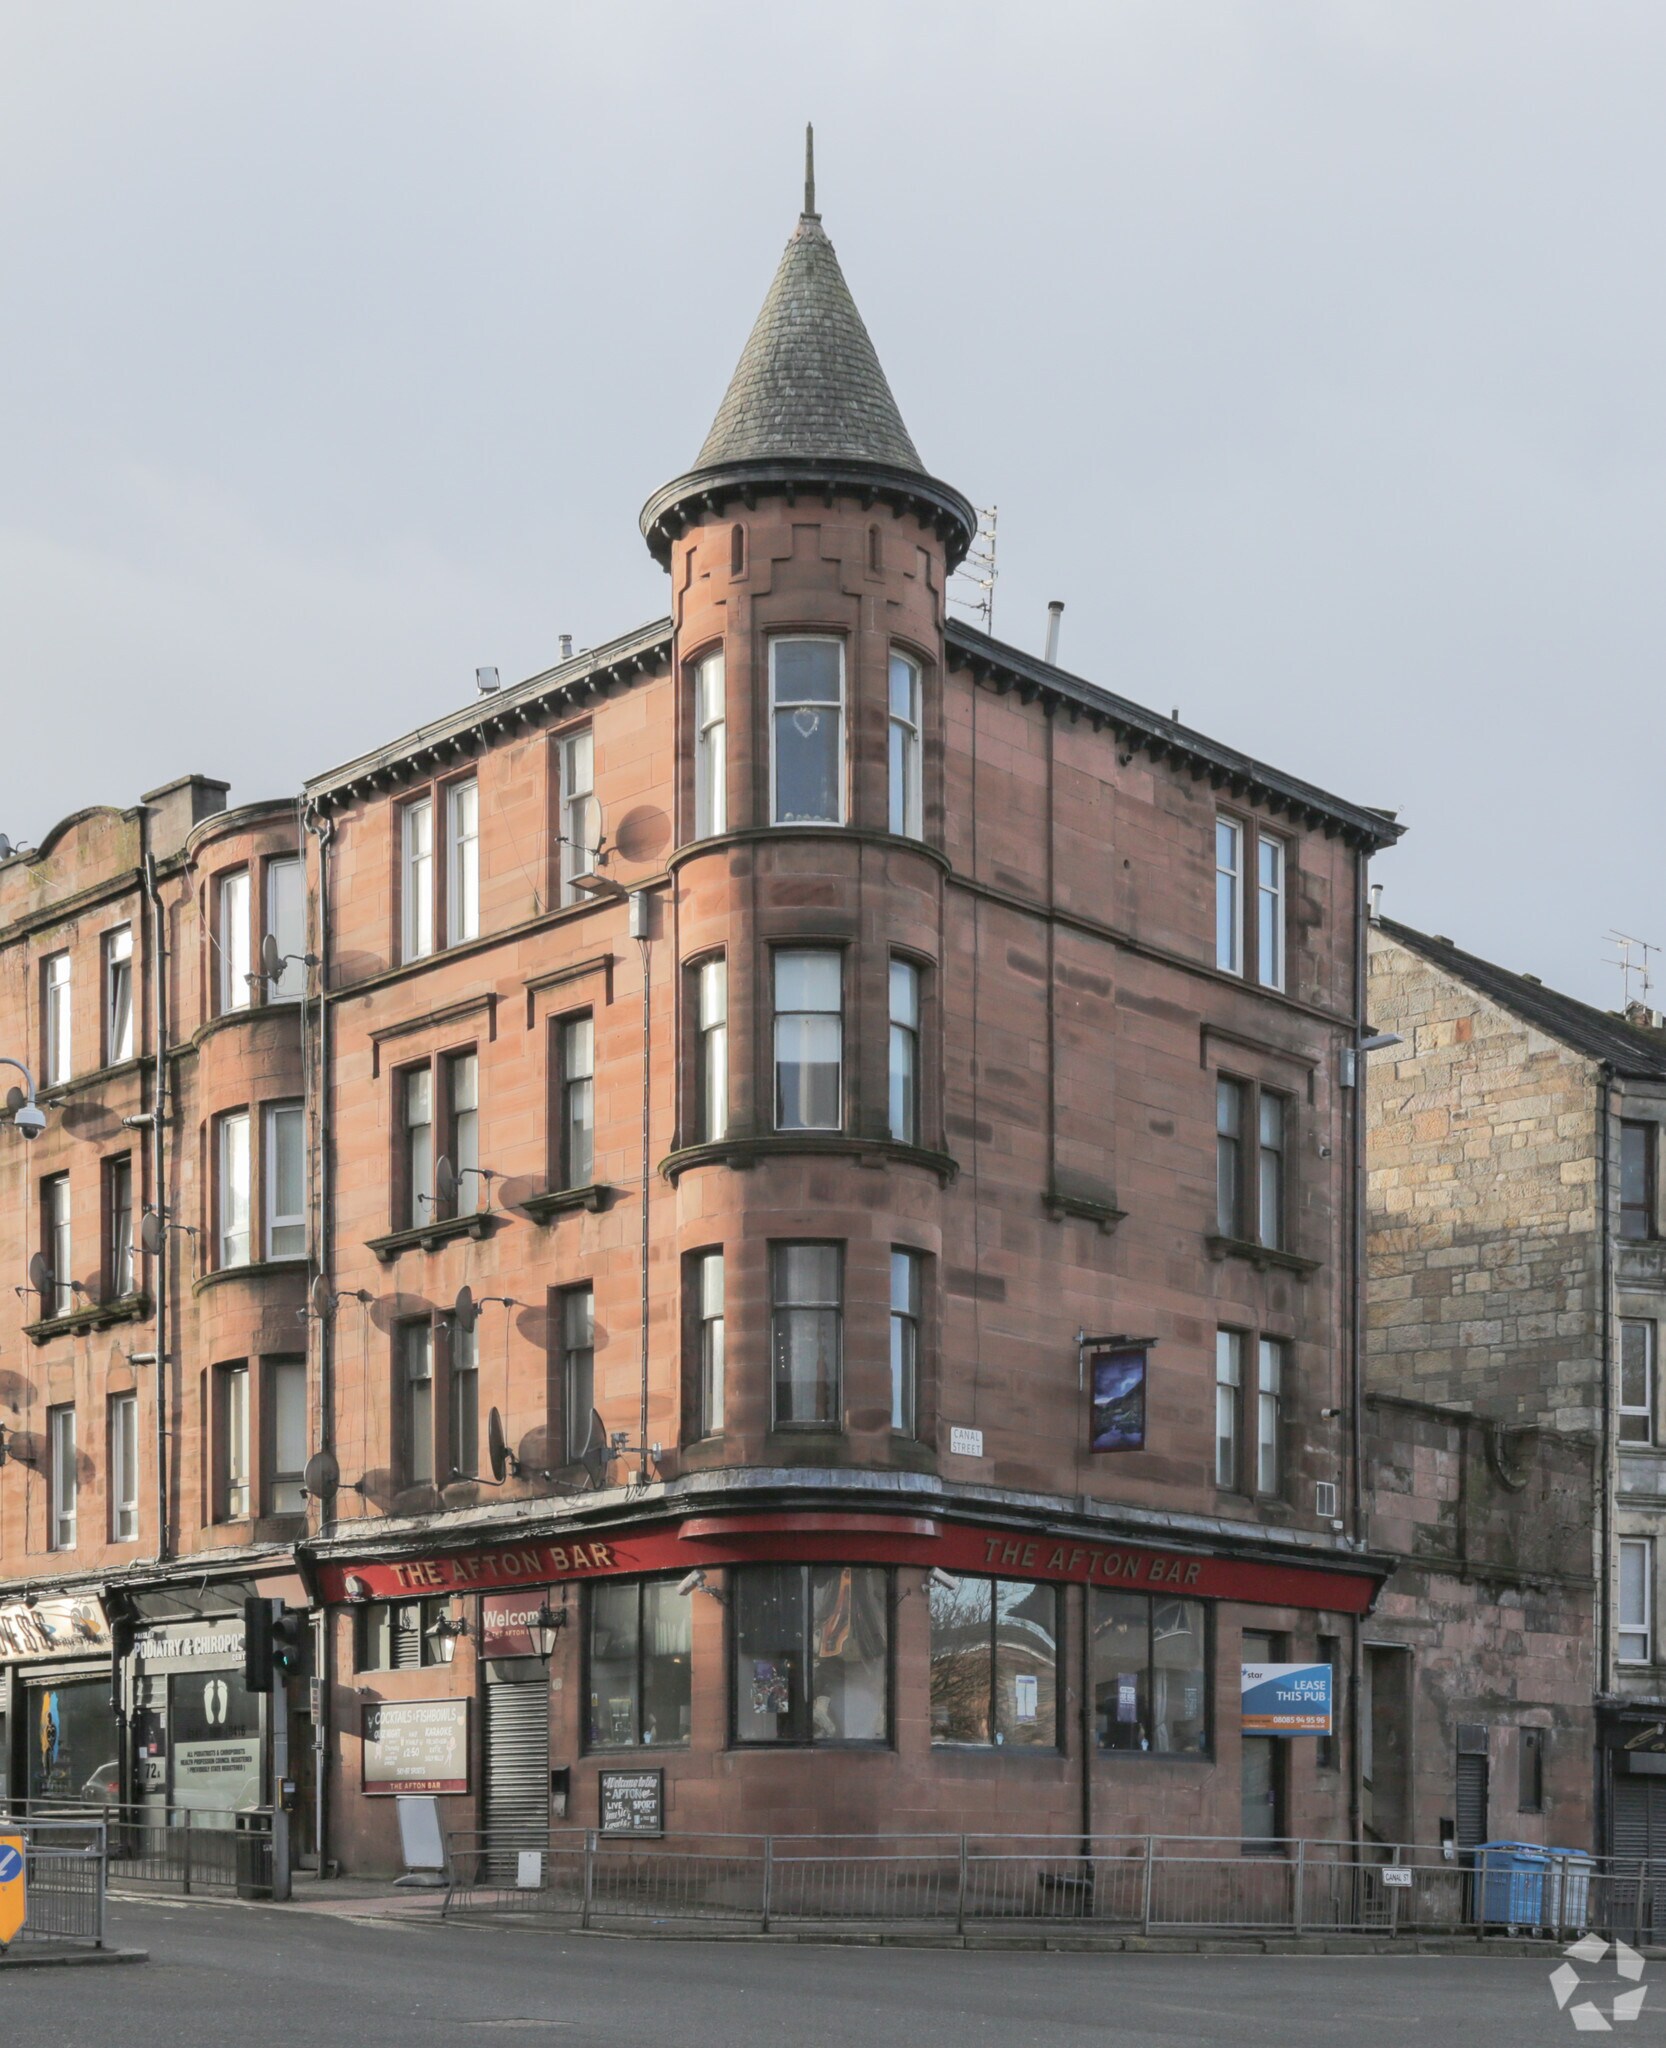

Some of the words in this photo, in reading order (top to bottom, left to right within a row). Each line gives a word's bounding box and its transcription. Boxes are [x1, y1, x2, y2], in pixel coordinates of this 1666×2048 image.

[953, 1428, 980, 1441] CANAL
[952, 1441, 981, 1454] STREET
[389, 1560, 442, 1588] THE
[451, 1550, 543, 1581] AFTON
[550, 1542, 611, 1571] BAR
[984, 1537, 1038, 1567] THE
[1046, 1546, 1142, 1578] AFTON
[1149, 1558, 1202, 1585] BAR
[482, 1609, 539, 1628] Welcom
[134, 1639, 181, 1659] PODIATRY
[183, 1638, 194, 1656] &
[1247, 1671, 1263, 1679] star
[1294, 1680, 1326, 1690] LEASE
[1276, 1691, 1302, 1701] THIS
[1304, 1691, 1326, 1701] PUB
[374, 1710, 411, 1725] COCKTAILS
[416, 1707, 457, 1724] FISHBOWLS
[424, 1726, 453, 1737] KARAOKE
[404, 1782, 426, 1790] AFTON
[427, 1781, 441, 1790] BAR
[607, 1801, 623, 1810] LIVE
[1385, 1873, 1402, 1882] CANAL
